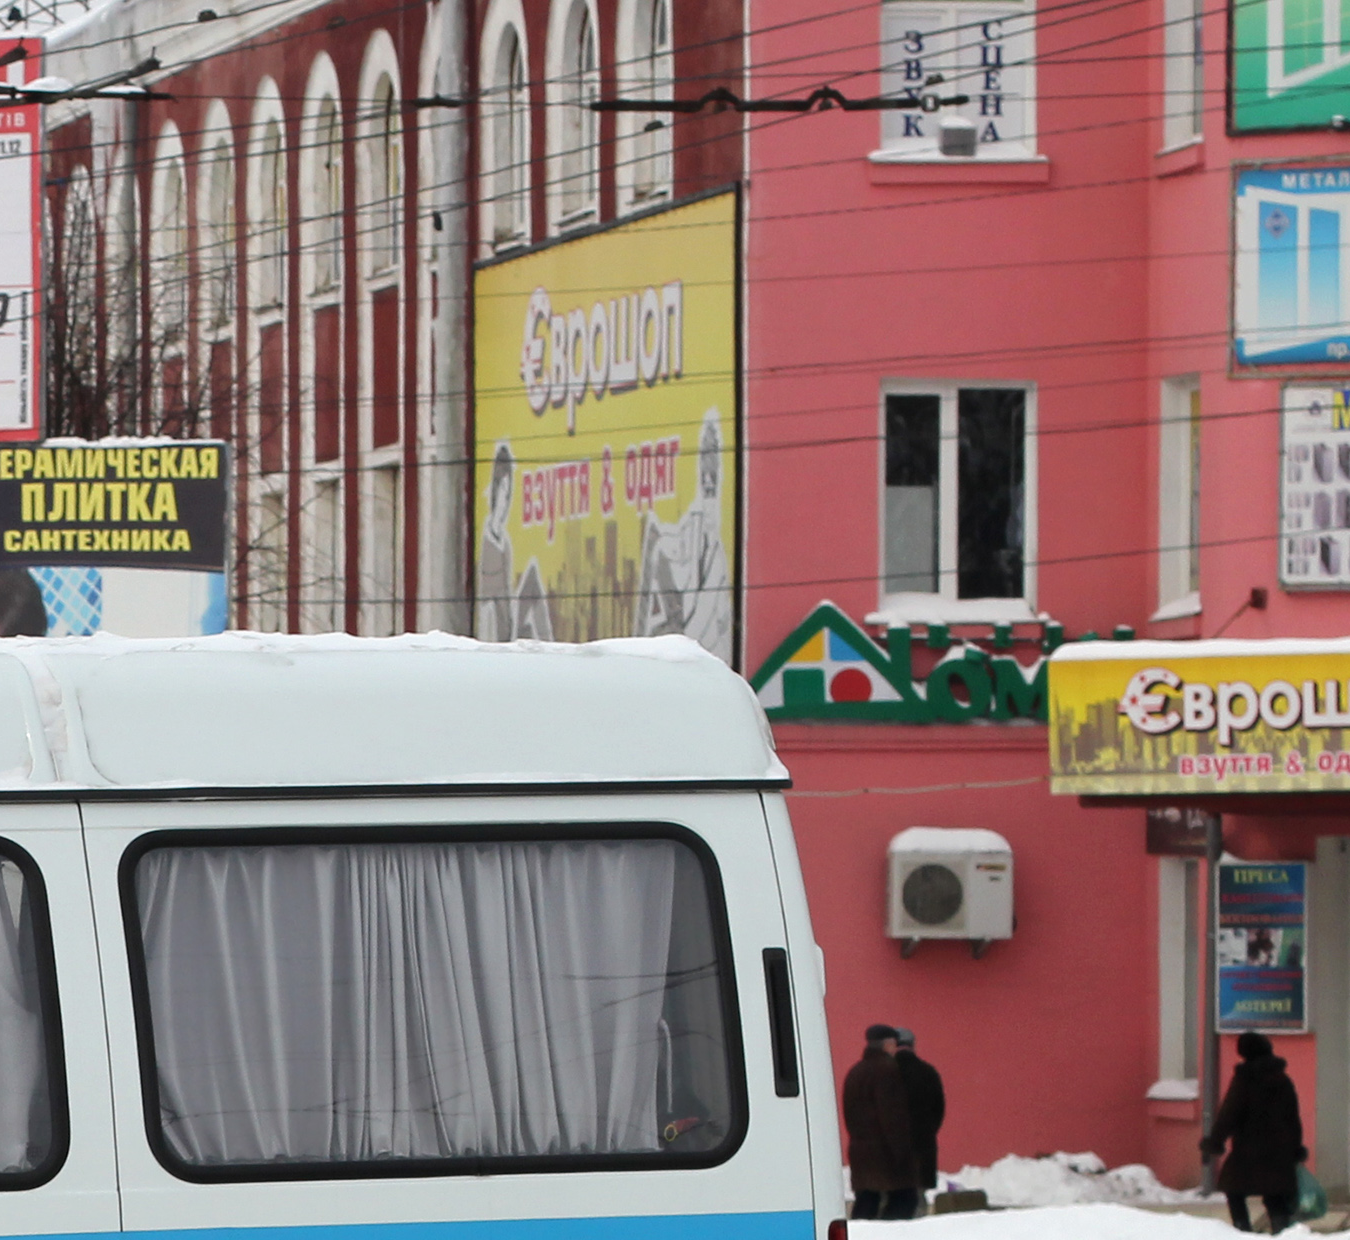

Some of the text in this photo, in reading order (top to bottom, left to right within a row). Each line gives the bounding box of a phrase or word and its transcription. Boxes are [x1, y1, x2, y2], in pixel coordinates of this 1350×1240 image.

[21, 482, 179, 523] ПЛИТКА
[522, 438, 681, 543] взуття & одяг
[4, 529, 192, 553] САНТЕХНИКА
[1180, 755, 1272, 781] взуття
[1286, 754, 1303, 775] &
